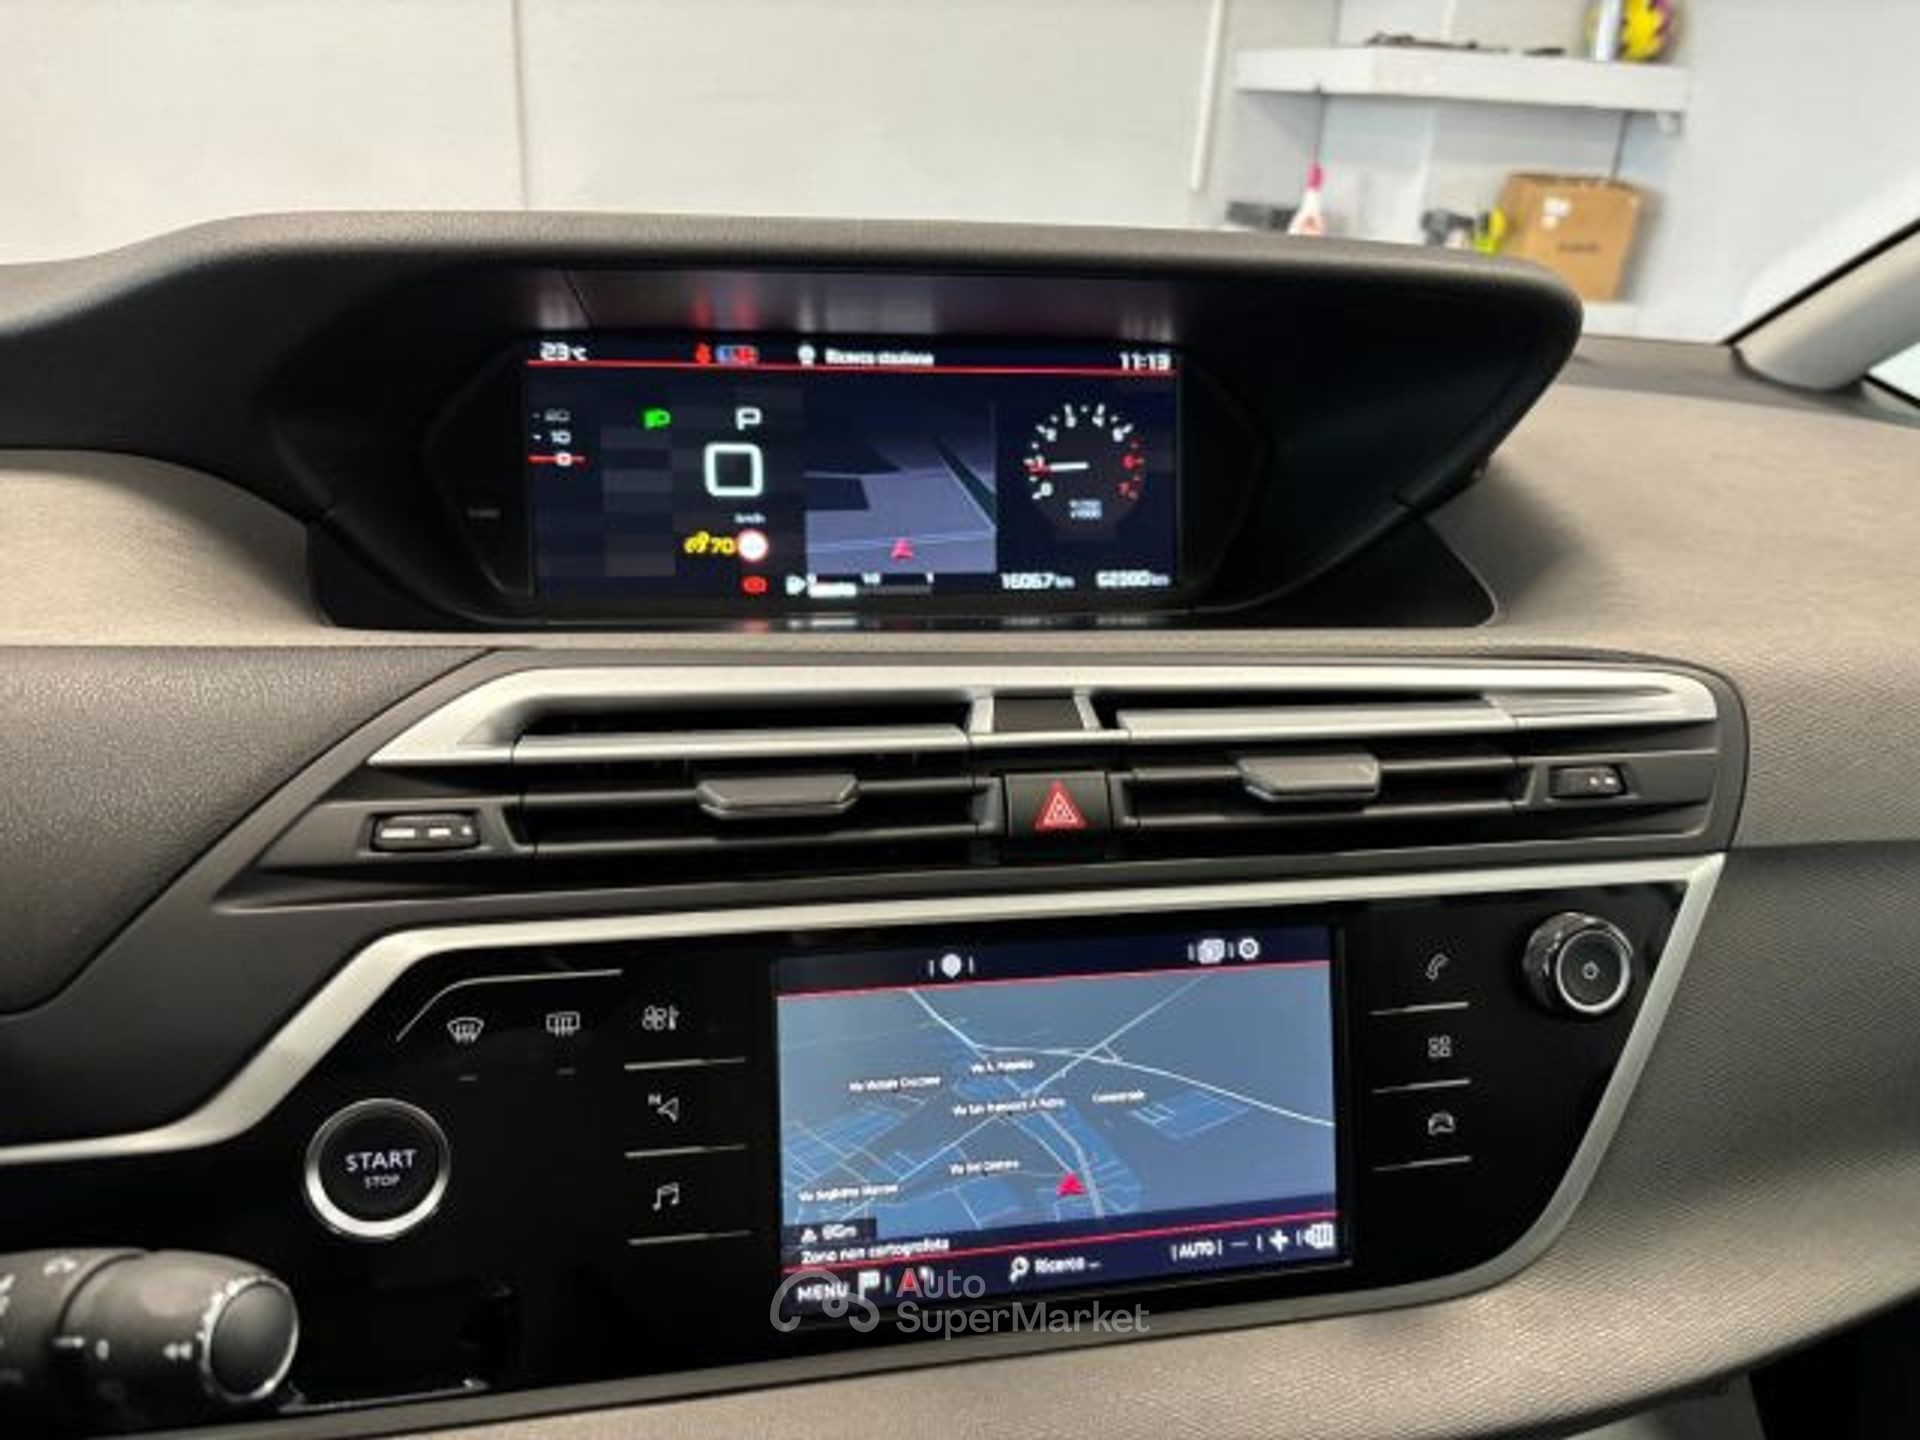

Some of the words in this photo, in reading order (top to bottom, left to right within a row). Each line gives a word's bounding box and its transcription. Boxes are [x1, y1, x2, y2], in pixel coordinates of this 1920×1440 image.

[1119, 352, 1171, 371] 11:13
[704, 442, 763, 496] 0
[345, 1149, 417, 1173] START
[364, 1174, 400, 1189] STOP
[797, 1283, 850, 1302] MENU
